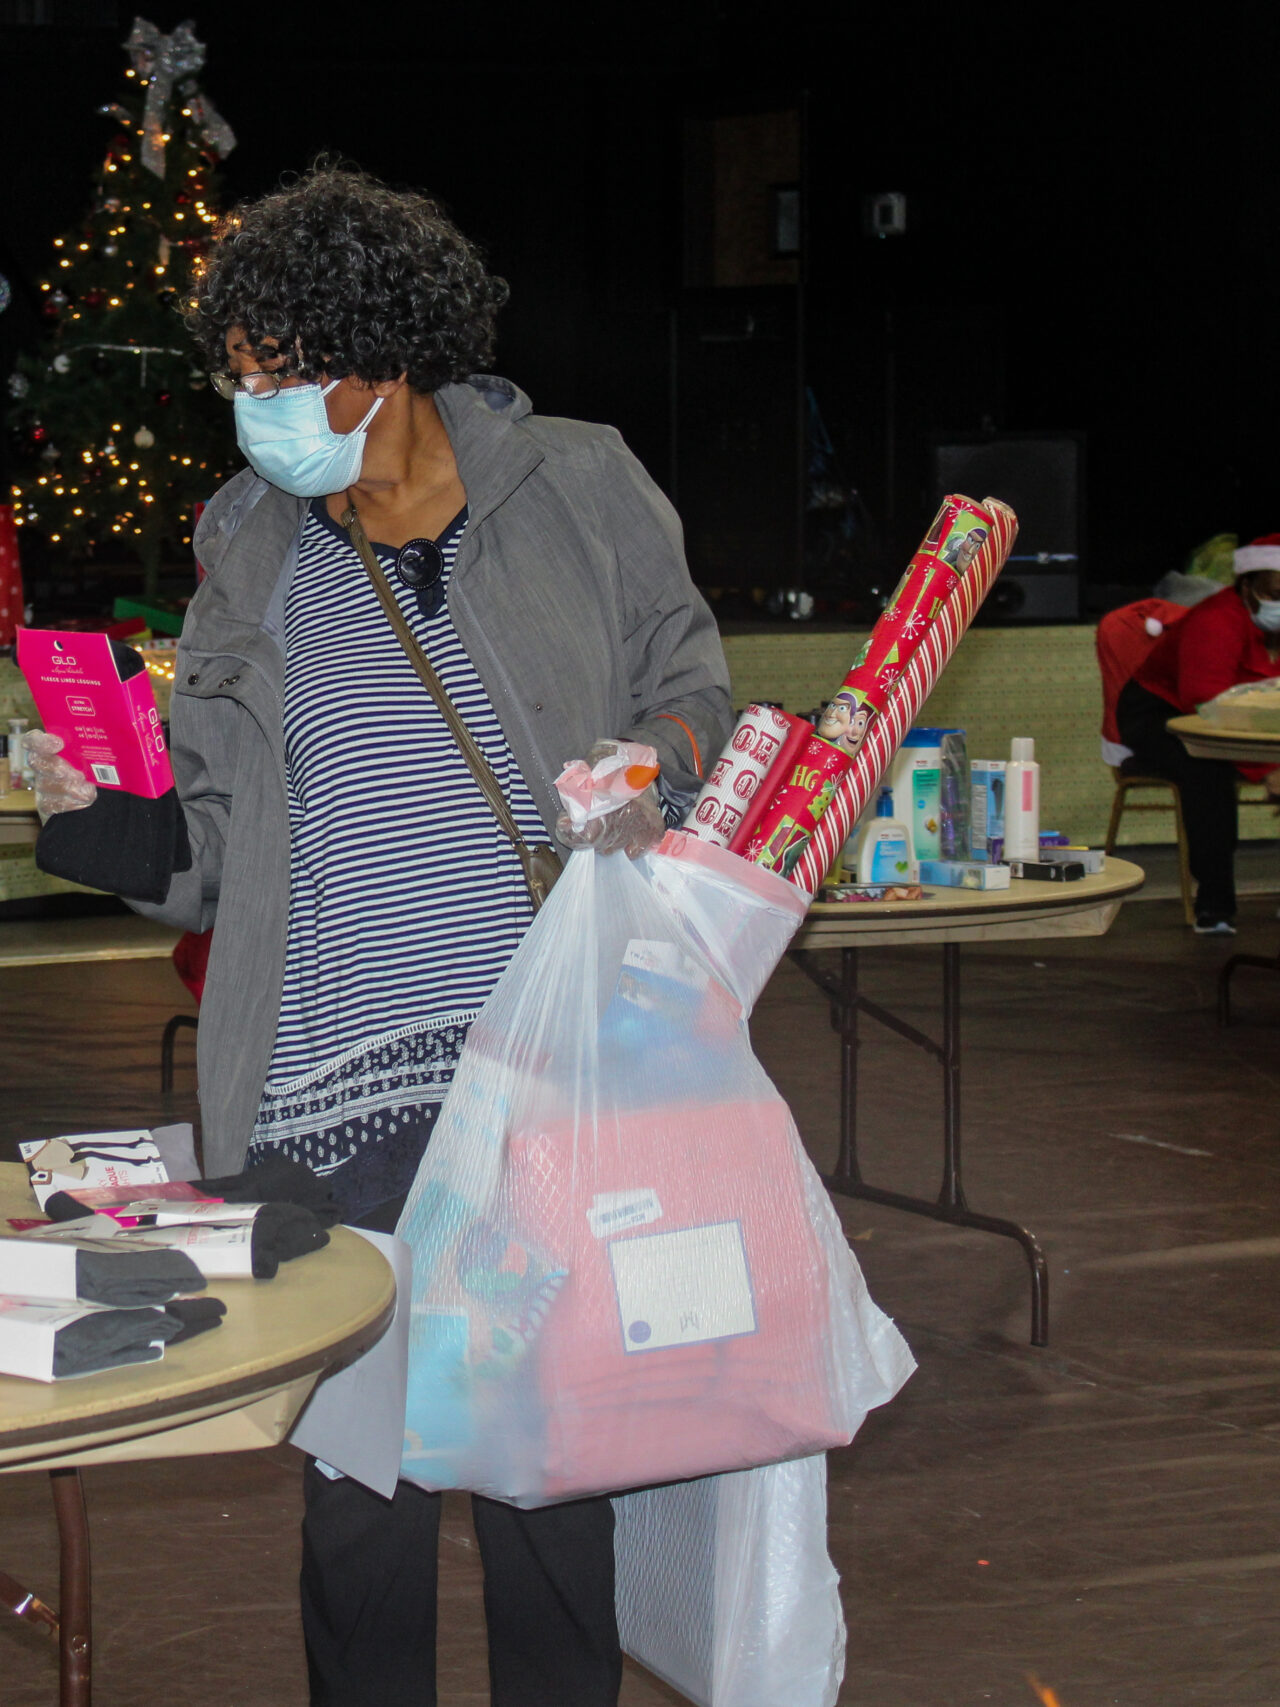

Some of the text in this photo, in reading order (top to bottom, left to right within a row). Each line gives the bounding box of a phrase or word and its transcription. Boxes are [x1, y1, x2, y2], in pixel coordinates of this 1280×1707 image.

[51, 655, 77, 666] GLO
[40, 675, 60, 683] FLEECE
[71, 705, 94, 713] STRETCH
[148, 707, 165, 753] GLO
[105, 1165, 121, 1188] AQUE
